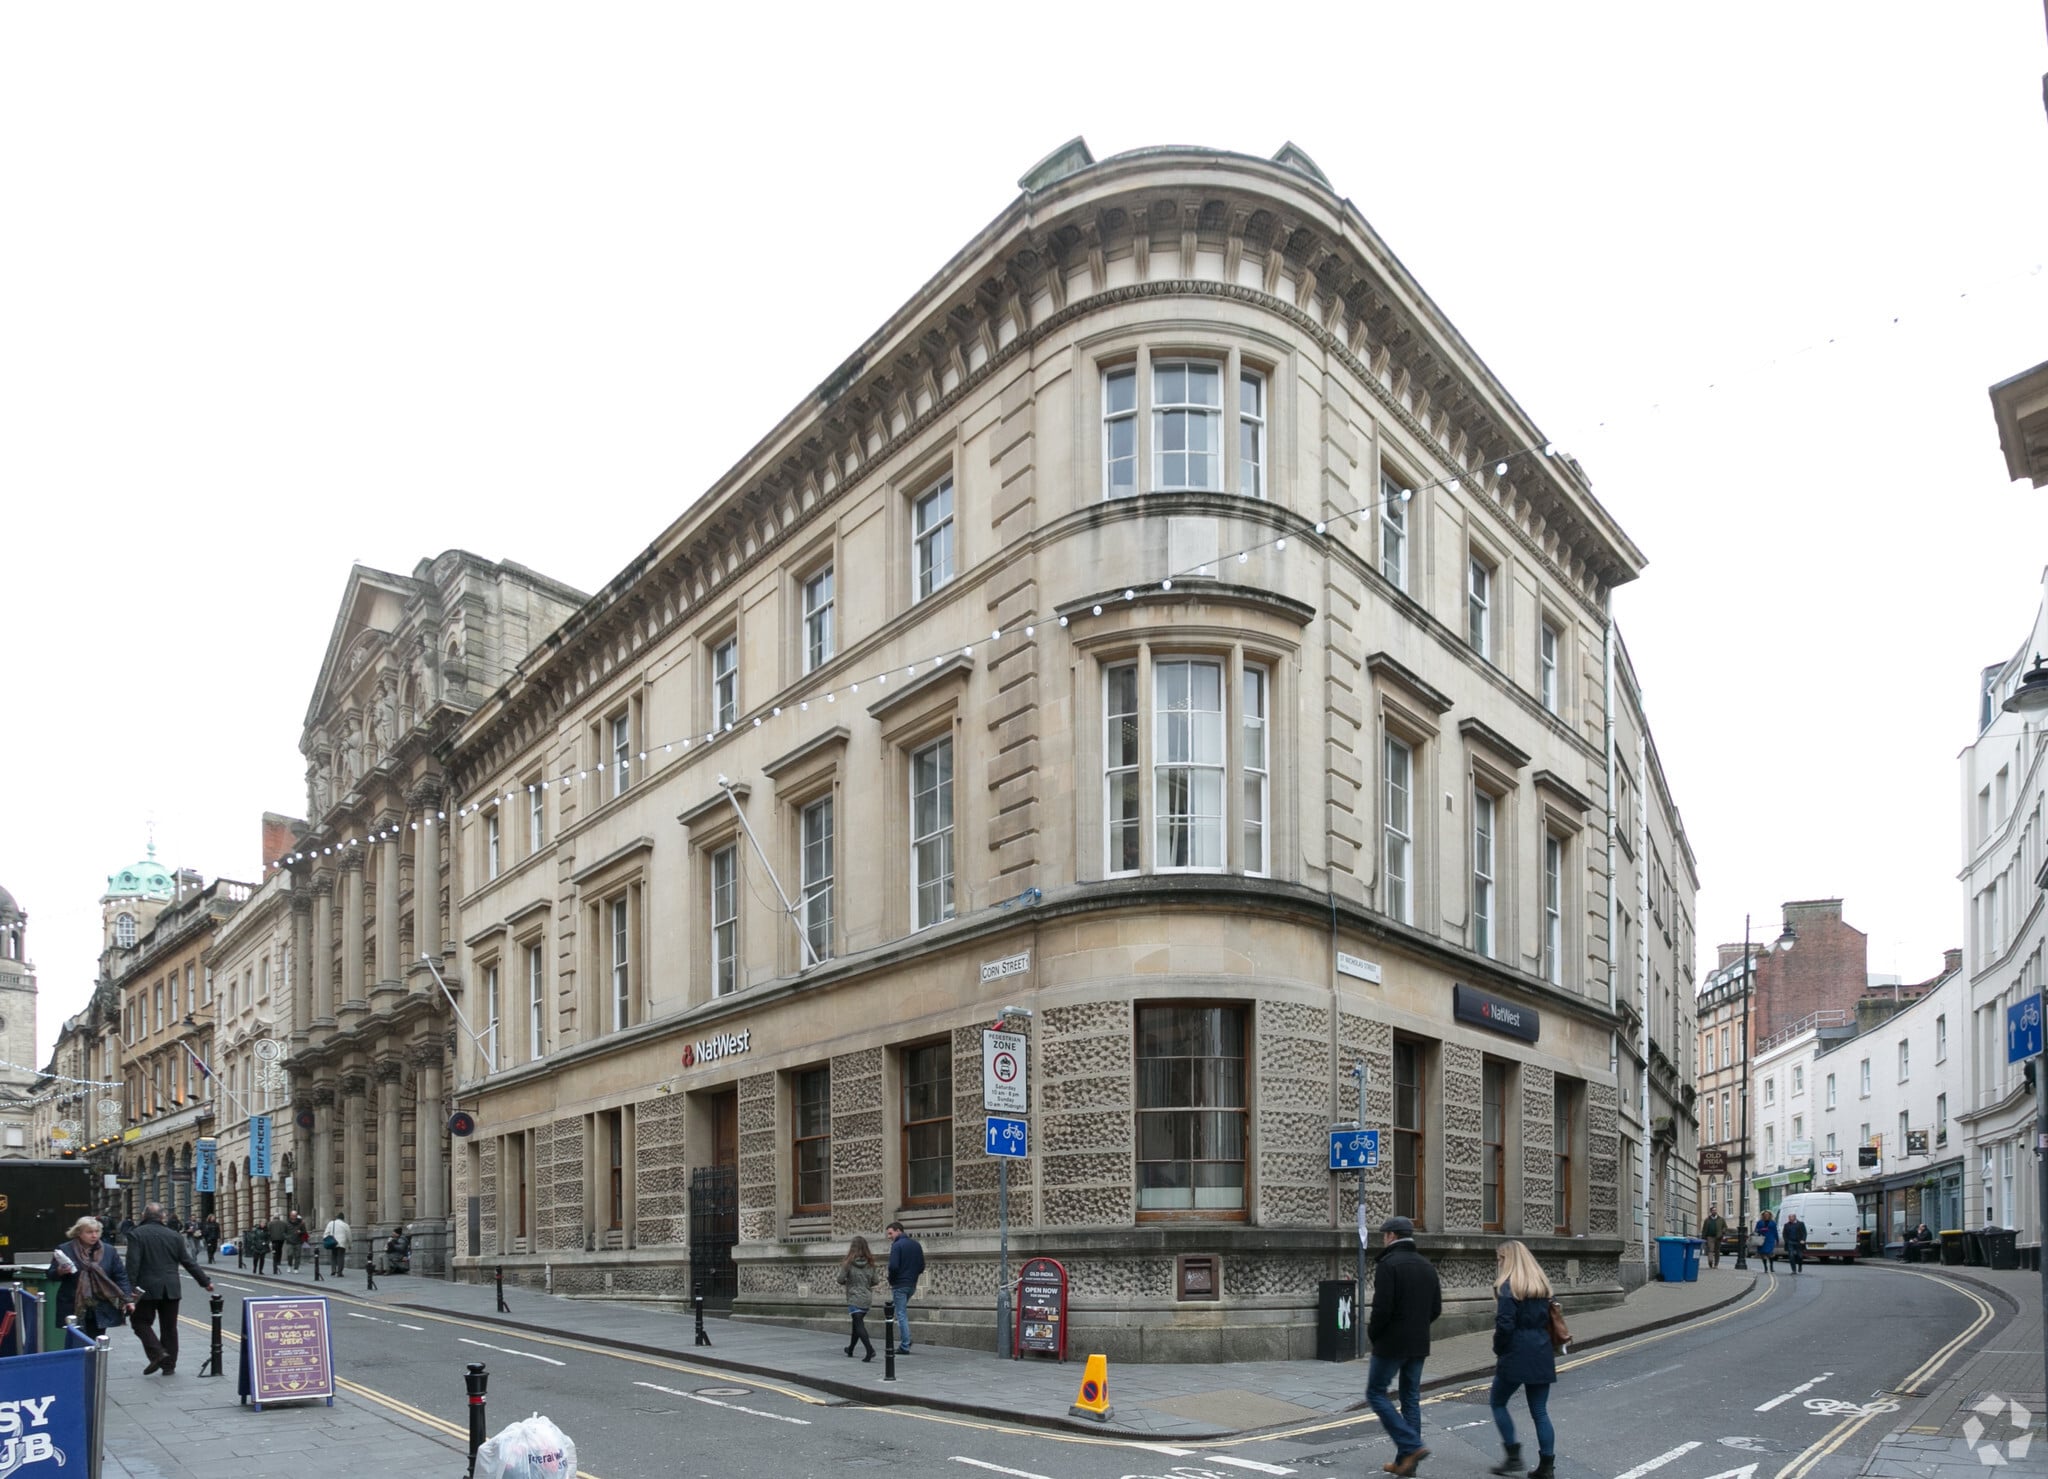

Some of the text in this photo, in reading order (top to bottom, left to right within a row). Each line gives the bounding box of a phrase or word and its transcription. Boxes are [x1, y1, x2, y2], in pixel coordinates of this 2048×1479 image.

[982, 965, 1000, 979] CORN
[1002, 958, 1026, 974] STREET
[1490, 1003, 1520, 1028] NatWest
[988, 1033, 1021, 1042] PEDESTRIAN
[696, 1028, 750, 1063] NatWest
[993, 1040, 1017, 1051] ZONE
[995, 1083, 1016, 1092] Saturday
[997, 1096, 1015, 1104] Sunday
[1042, 1287, 1058, 1295] NOW
